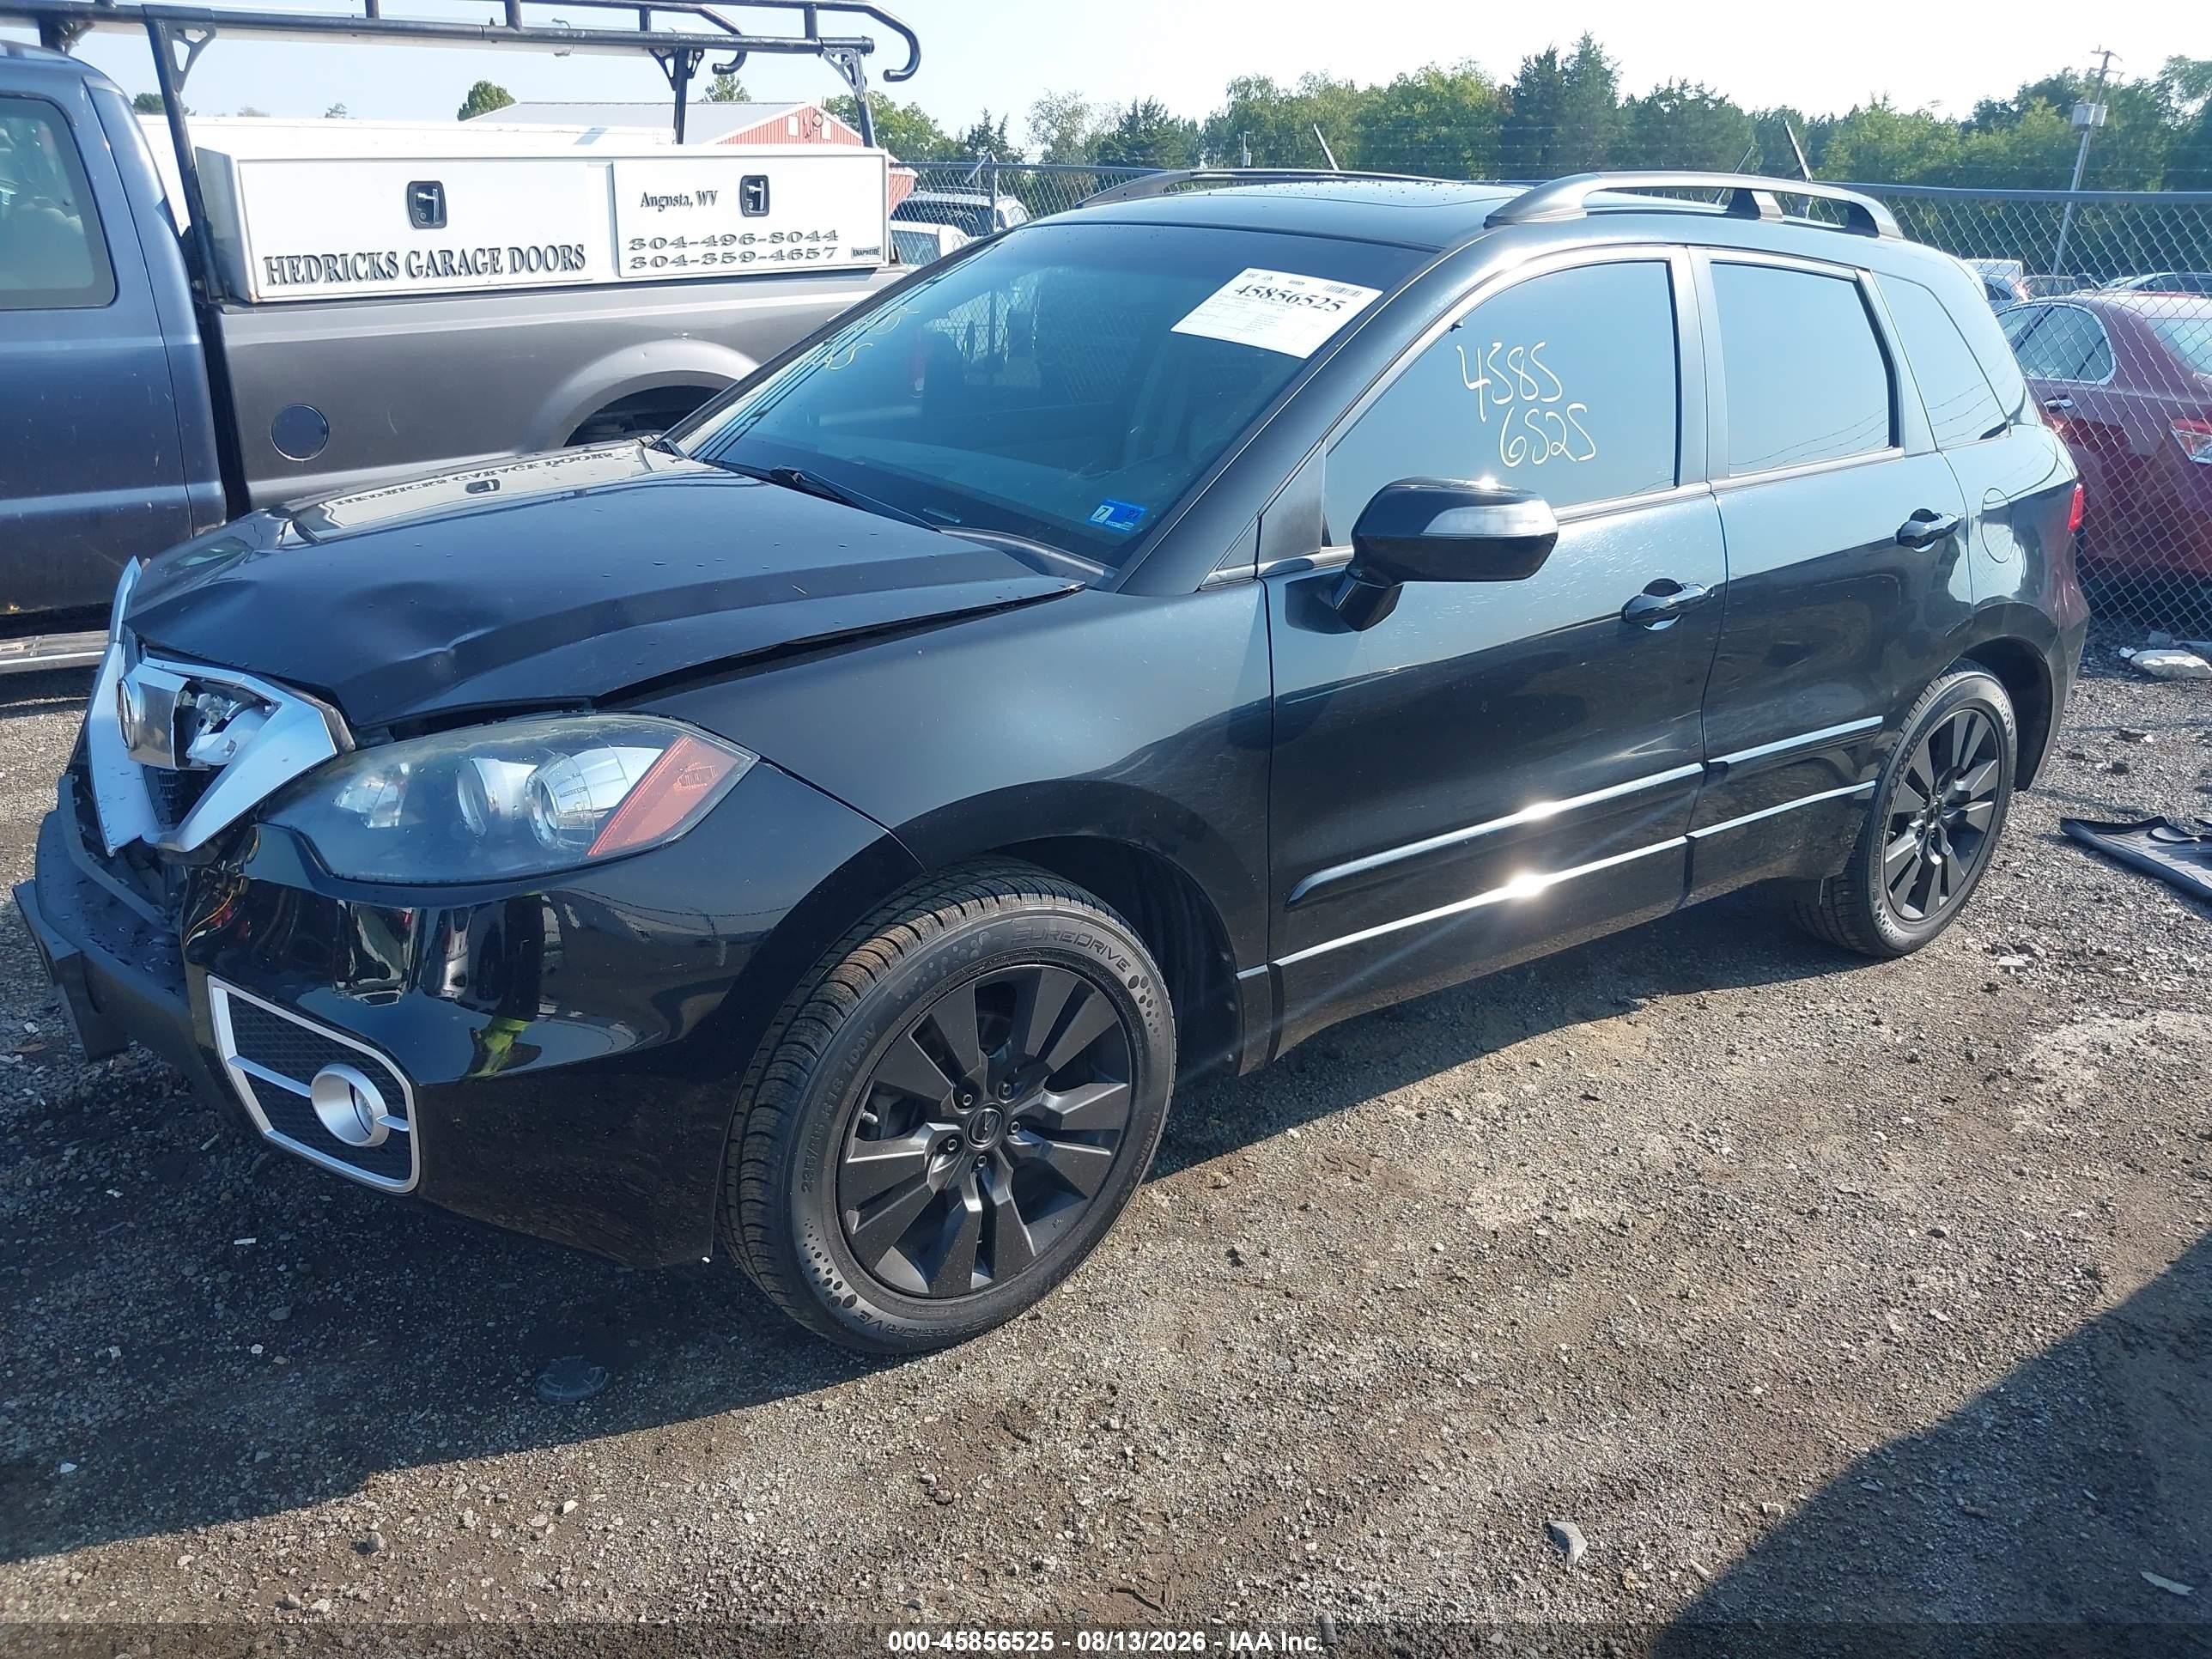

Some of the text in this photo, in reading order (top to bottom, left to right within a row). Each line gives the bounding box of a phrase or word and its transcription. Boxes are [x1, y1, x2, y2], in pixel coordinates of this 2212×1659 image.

[696, 190, 719, 207] WV
[629, 229, 839, 252] 304-496-8044
[629, 246, 838, 270] 304-359-4657
[263, 243, 586, 287] HEDRICKS GARAGE DOORS
[1234, 283, 1347, 313] 45856525
[1456, 342, 1563, 423] 4585
[1499, 403, 1596, 468] 6525
[1012, 926, 1133, 974] SUREDRIVE
